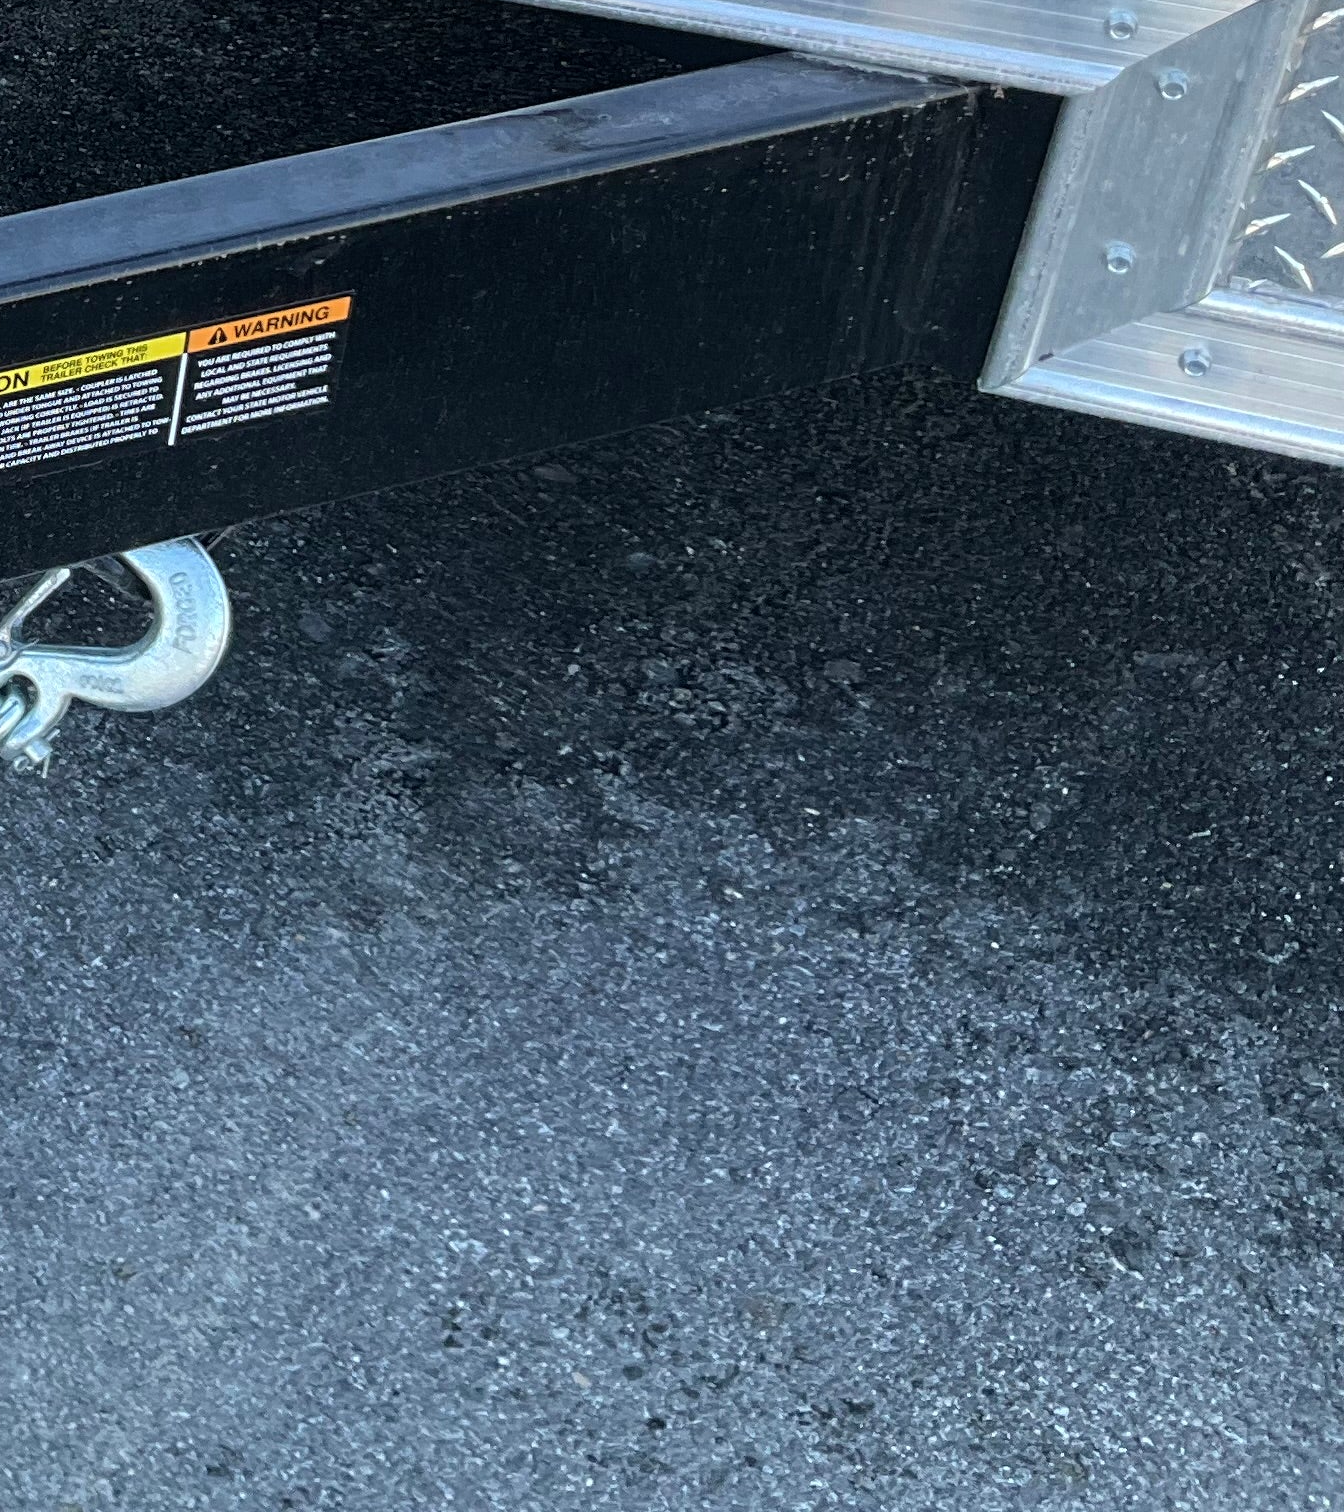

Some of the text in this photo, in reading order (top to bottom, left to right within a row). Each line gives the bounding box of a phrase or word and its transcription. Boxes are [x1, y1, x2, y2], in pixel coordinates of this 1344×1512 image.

[233, 305, 329, 338] WARNING
[40, 366, 81, 383] TRAILER
[84, 358, 118, 373] CHECK
[42, 343, 148, 374] BEFORE TOWING THIS
